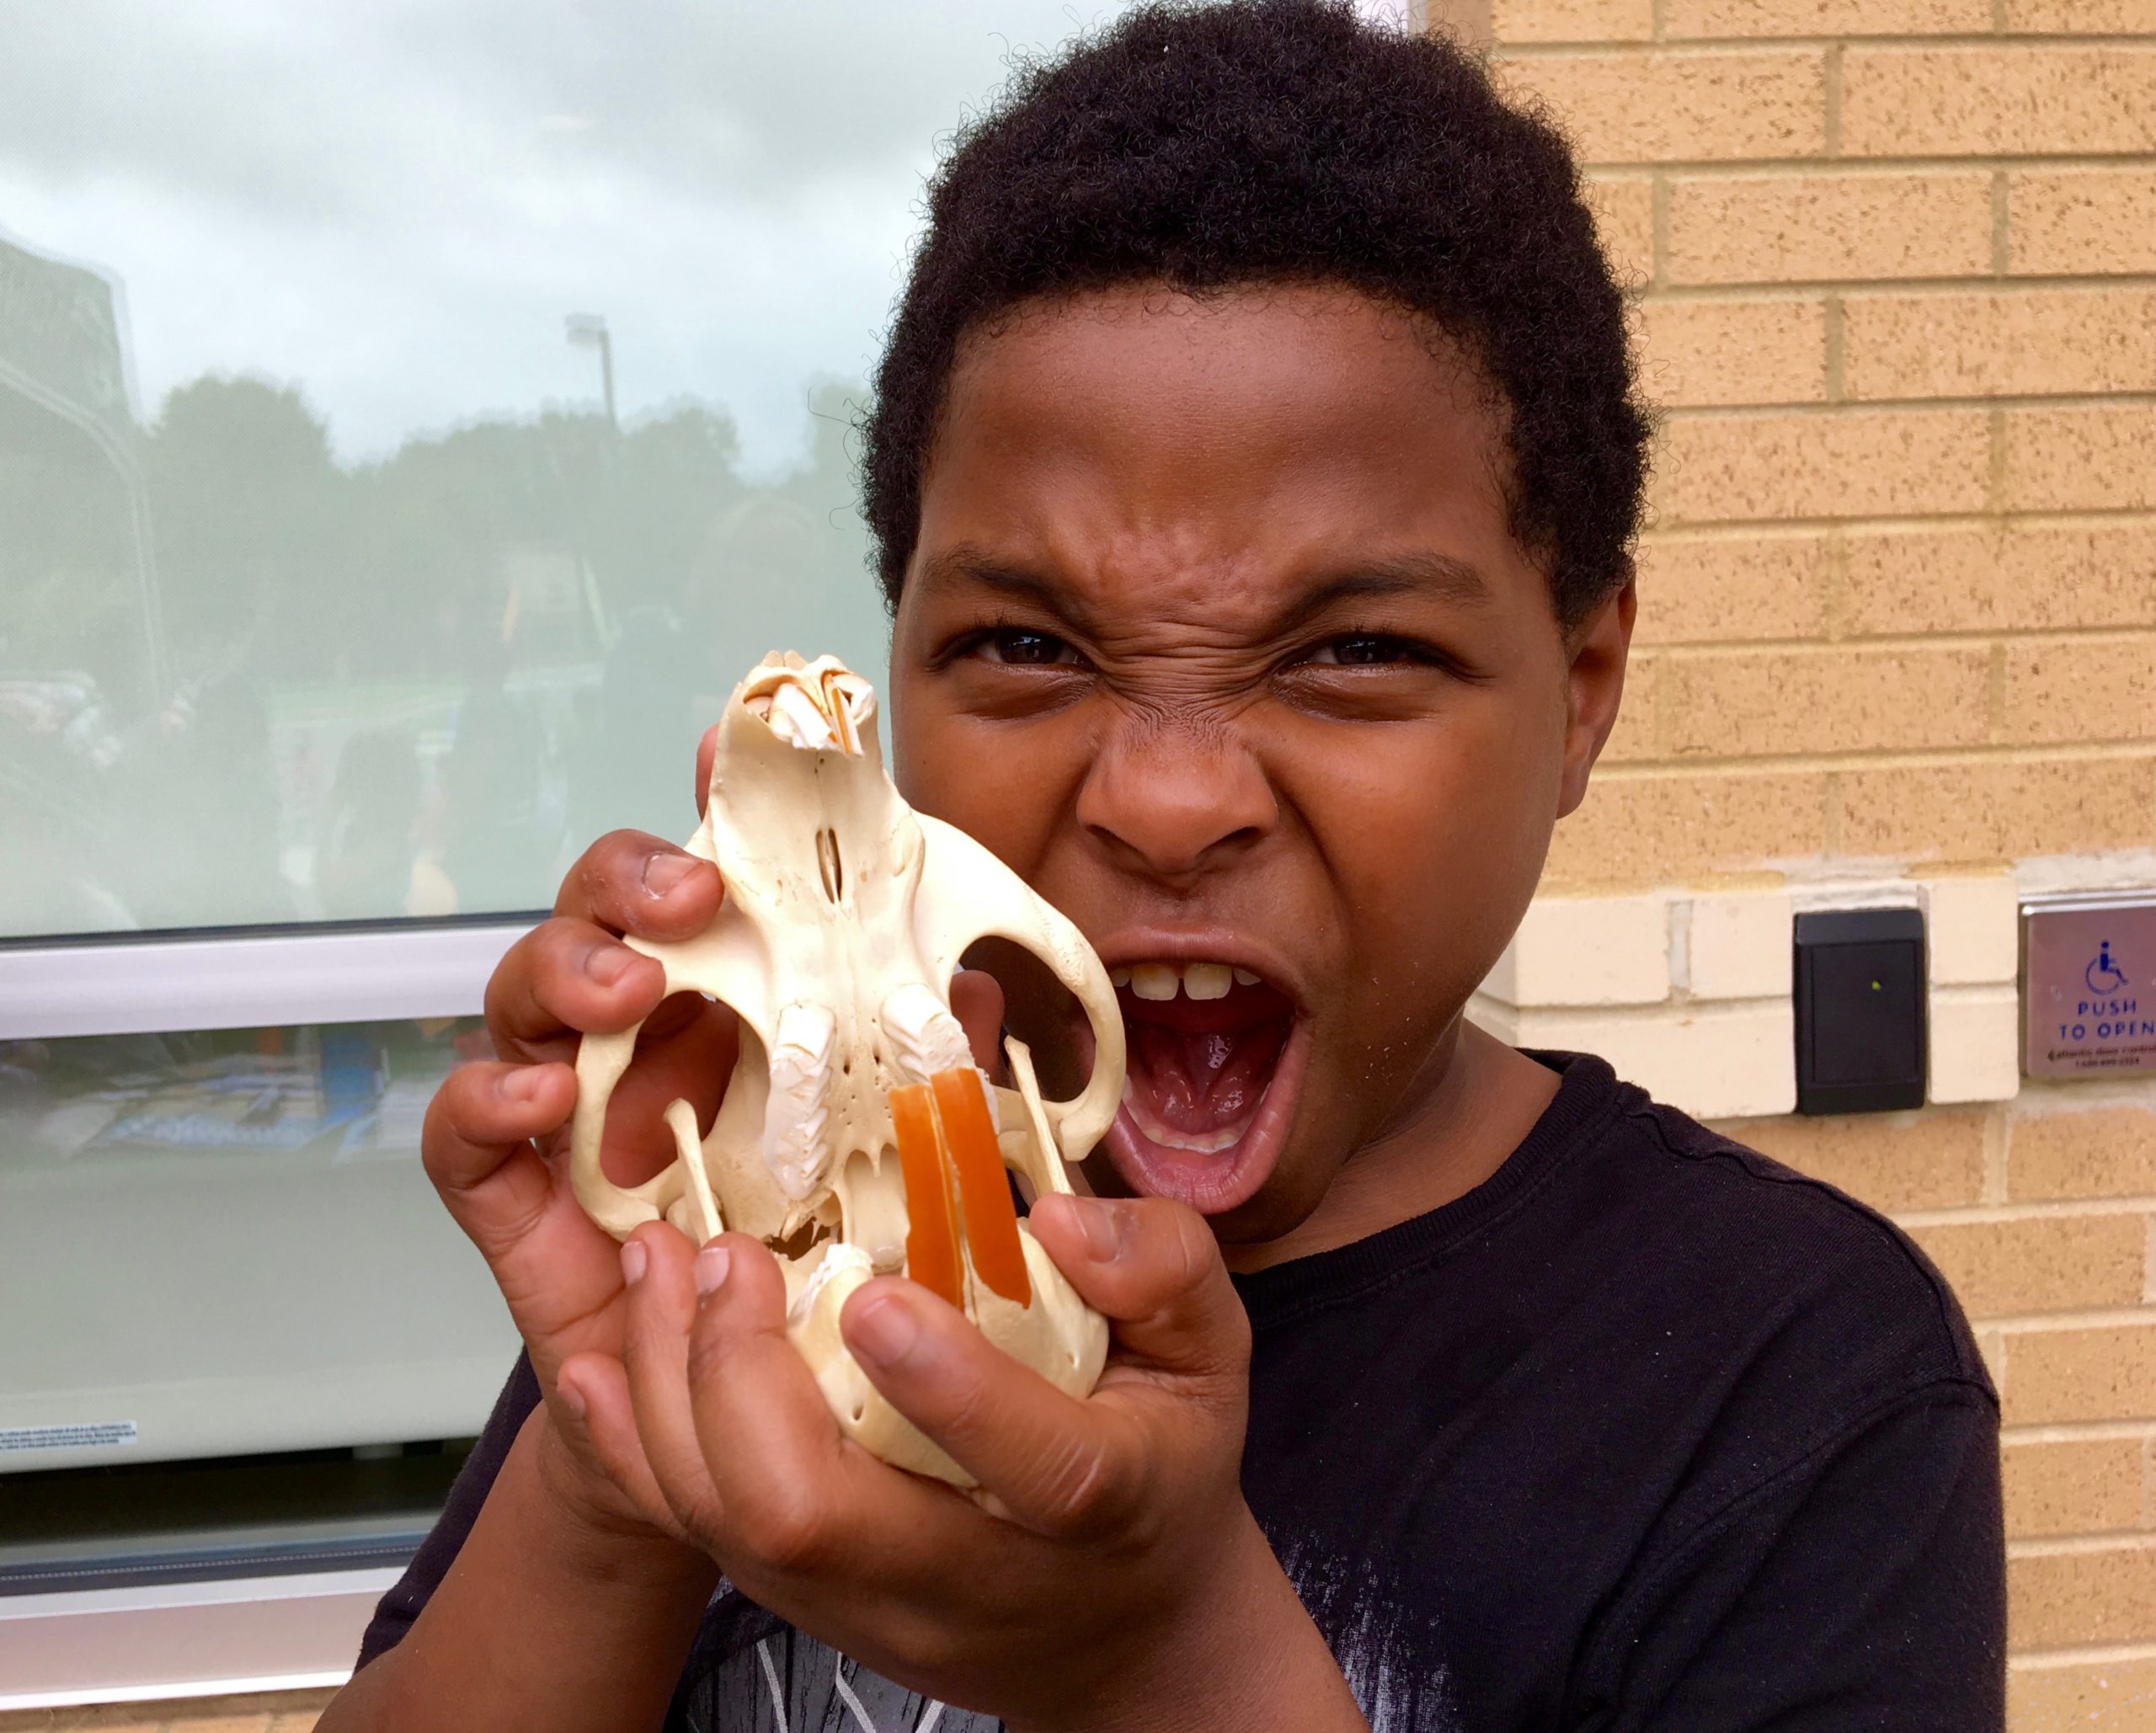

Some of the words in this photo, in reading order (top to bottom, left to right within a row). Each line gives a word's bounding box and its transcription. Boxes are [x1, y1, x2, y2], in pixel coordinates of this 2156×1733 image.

[2078, 1000, 2136, 1016] PUSH
[2059, 1024, 2085, 1040] TO
[2098, 1021, 2155, 1038] OPEN
